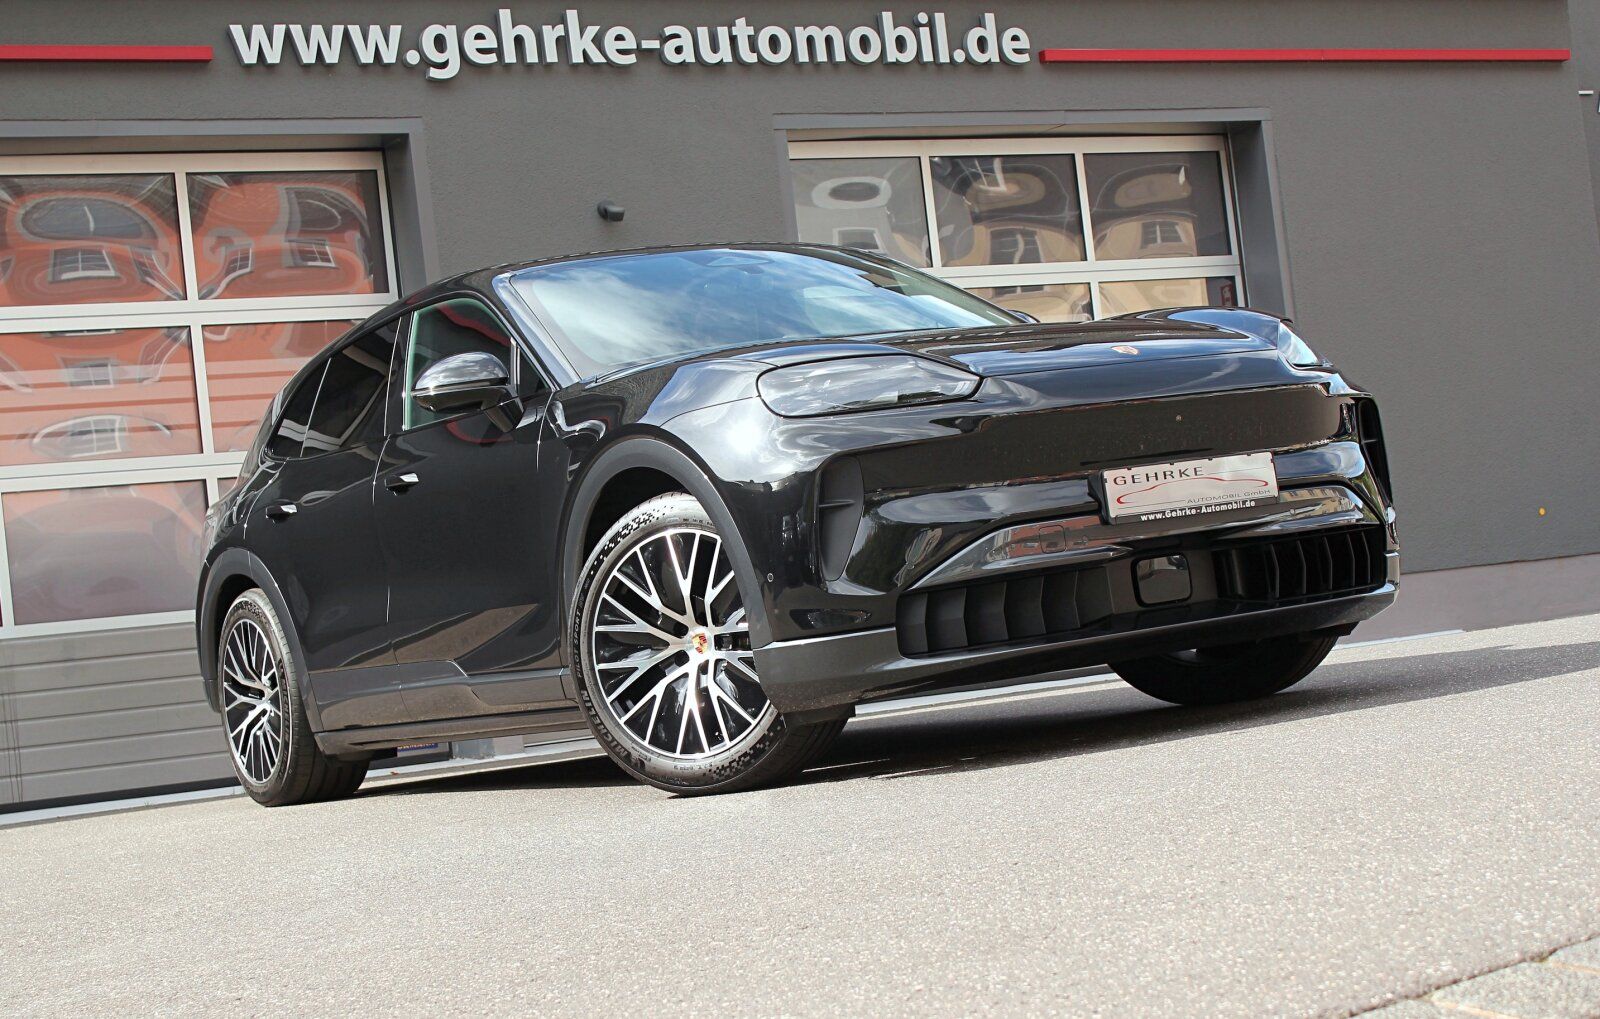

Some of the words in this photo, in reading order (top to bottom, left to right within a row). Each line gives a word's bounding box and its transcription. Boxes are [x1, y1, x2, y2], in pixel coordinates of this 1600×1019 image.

[228, 10, 1030, 79] www.gehrke-automobil.de
[1114, 466, 1204, 486] GEHRKE
[1140, 500, 1255, 521] www.Gehrke-Automobil.de
[1187, 493, 1241, 504] AUTOMOBIL
[1243, 489, 1270, 497] GmbH
[573, 611, 581, 644] SPORT
[574, 649, 582, 678] PILOT
[580, 690, 629, 757] MICHELIN
